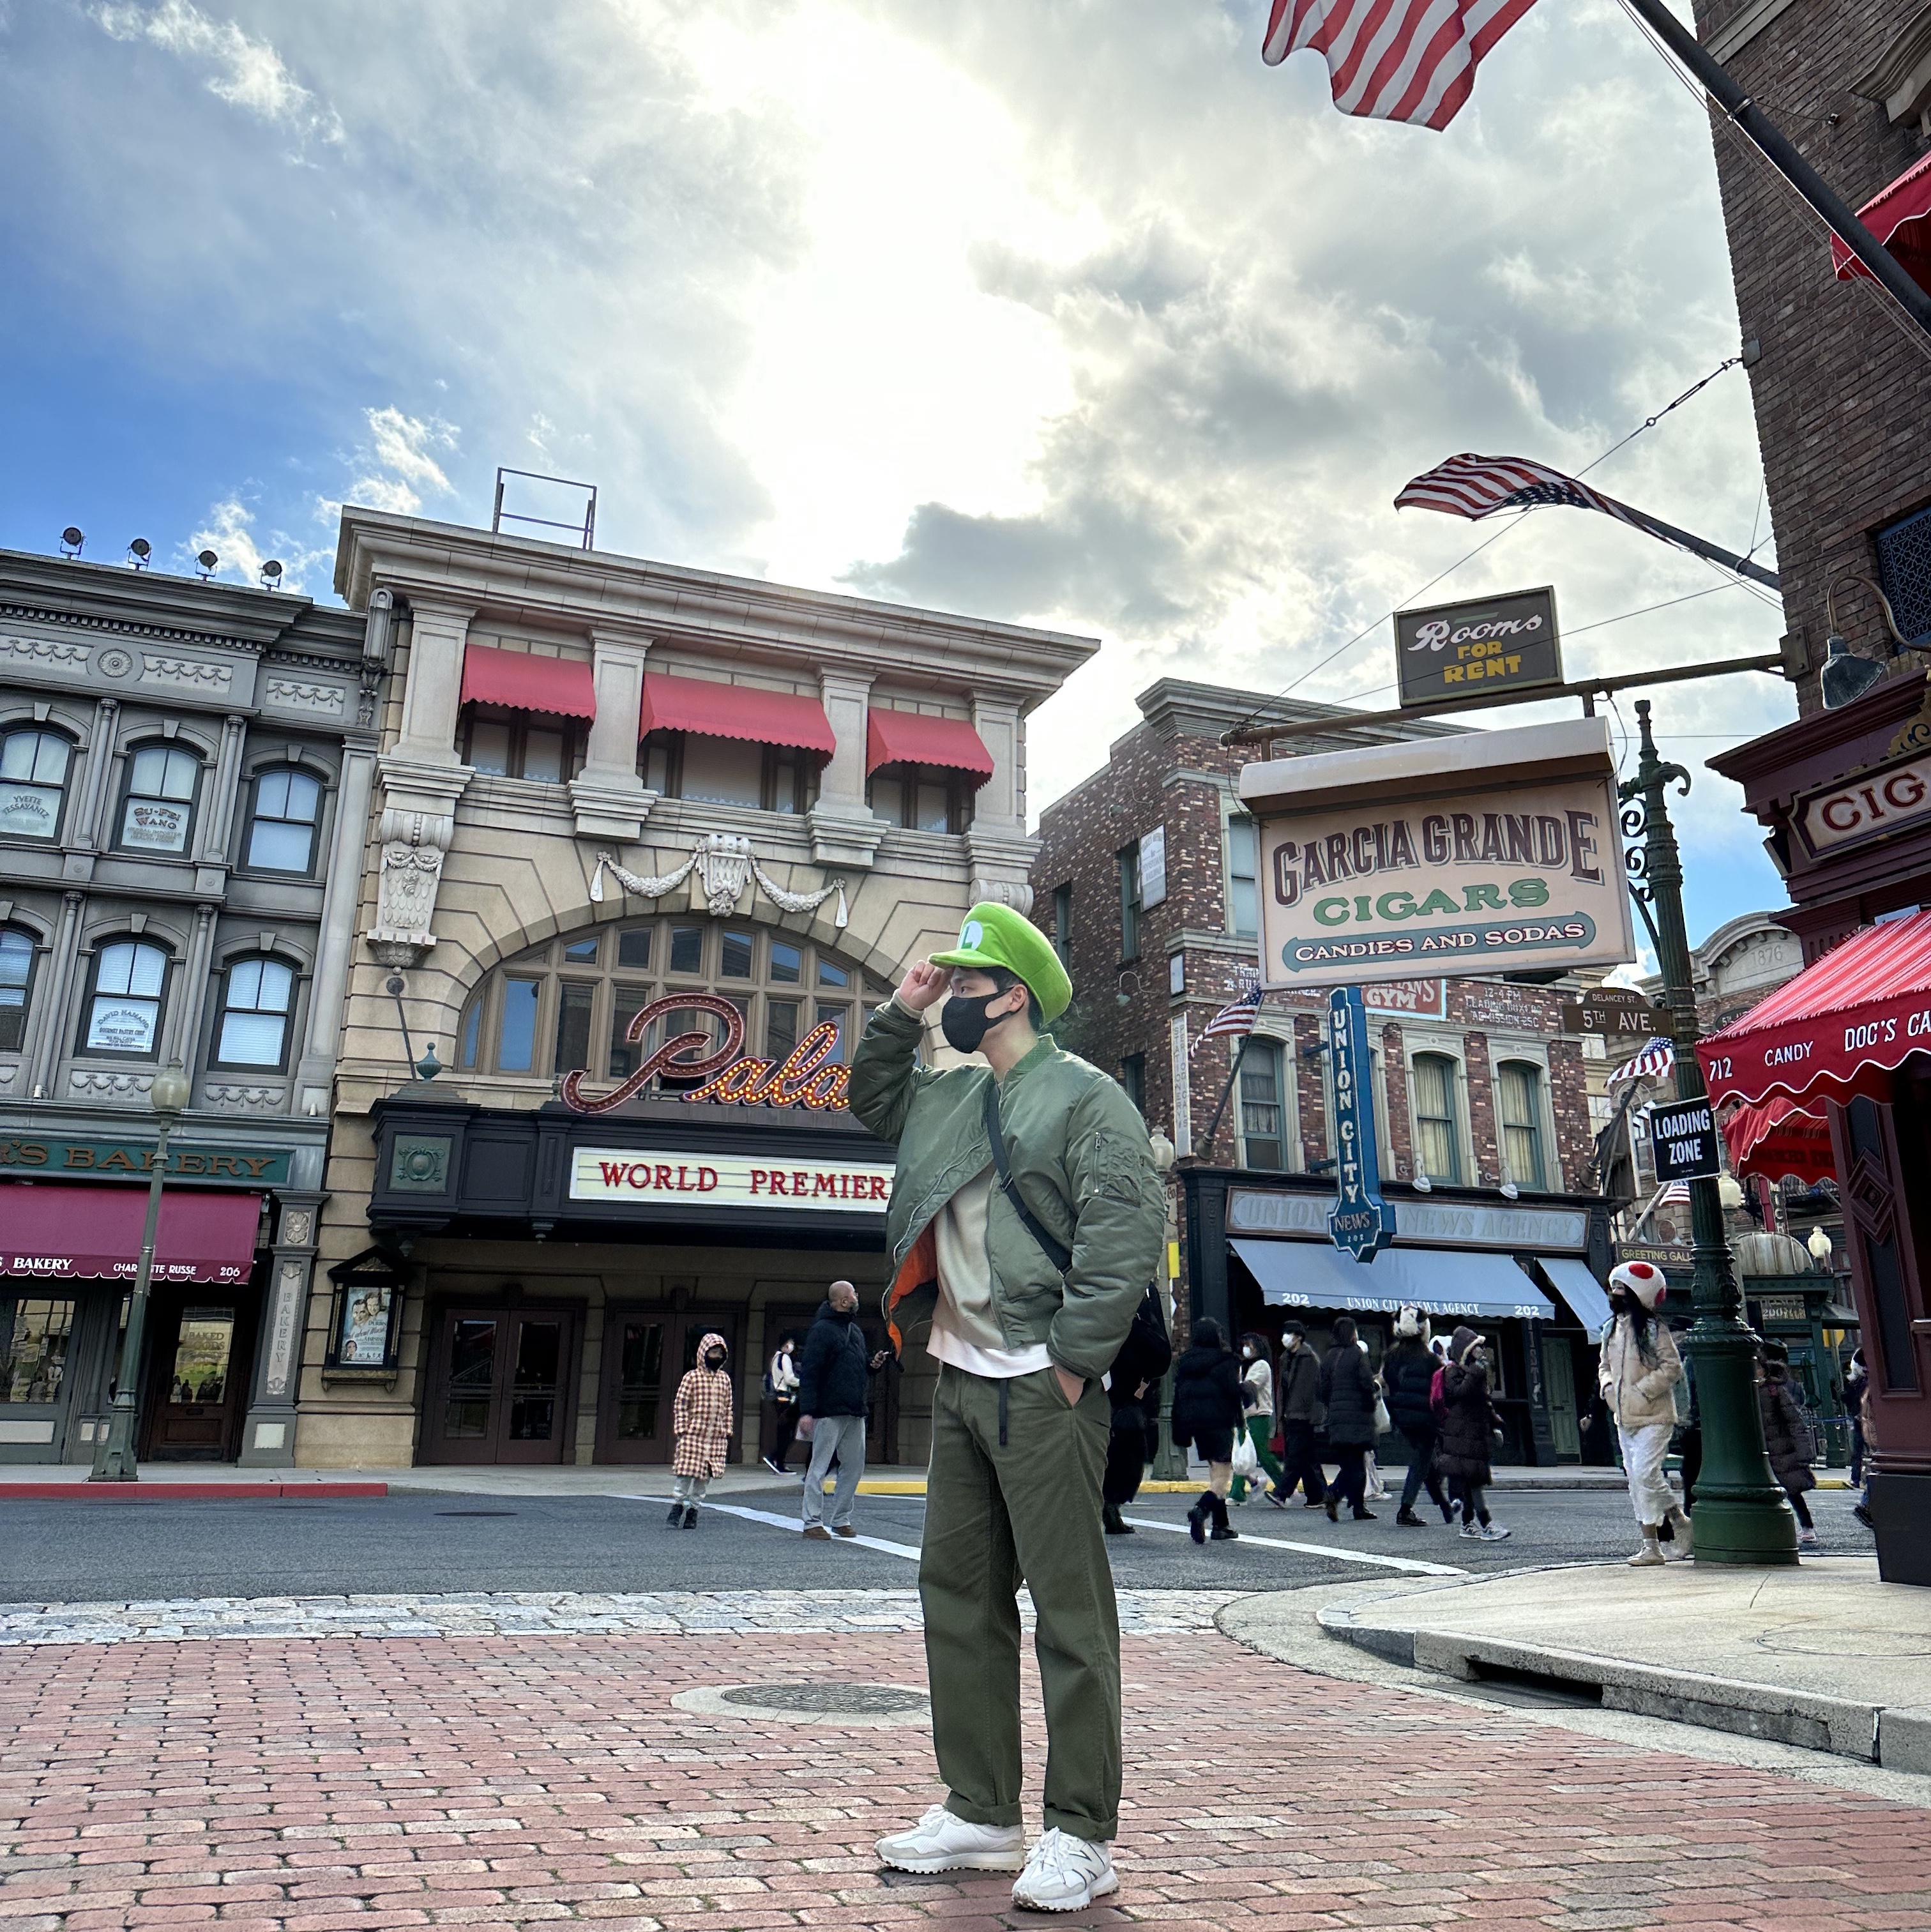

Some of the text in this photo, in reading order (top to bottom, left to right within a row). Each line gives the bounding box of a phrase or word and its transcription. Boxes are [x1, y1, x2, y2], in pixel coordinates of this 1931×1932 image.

[1407, 614, 1543, 651] Rooms
[1457, 641, 1503, 659] FOR
[1443, 655, 1521, 683] RENT
[13, 795, 42, 805] YVETTE
[1822, 771, 1927, 832] CIG
[1273, 810, 1605, 906] GARCIA GRANDE
[1313, 878, 1550, 926] CIGARS
[961, 925, 973, 949] L
[1294, 924, 1585, 962] CANDIES AND SODAS
[1752, 945, 1783, 966] 1876
[1367, 987, 1417, 1009] GYM
[1506, 990, 1522, 1001] PM
[1592, 993, 1625, 1003] DELANCEY
[1582, 1010, 1657, 1032] 5TH AVE.
[1844, 1017, 1898, 1053] DOC'S
[1764, 1040, 1814, 1067] CANDY
[1709, 1057, 1733, 1082] 712
[1333, 1010, 1358, 1205] UNION CITY
[1655, 1109, 1711, 1139] LOADING
[1669, 1138, 1702, 1165] ZONE
[599, 1162, 718, 1192] WORLD
[1246, 1196, 1574, 1242] UNION NEWS AGENCY
[1334, 1211, 1370, 1233] NEWS
[13, 1257, 73, 1270] BAKERY
[1622, 1249, 1667, 1260] GREETING
[169, 1264, 197, 1275] RUSSE
[220, 1266, 241, 1277] 206
[1282, 1292, 1310, 1305] 202
[1347, 1297, 1380, 1309] UNION
[1443, 1302, 1480, 1314] AGENCY
[1515, 1304, 1540, 1316] 202
[189, 1332, 225, 1341] BAKED
[276, 1292, 292, 1362] BAKERY
